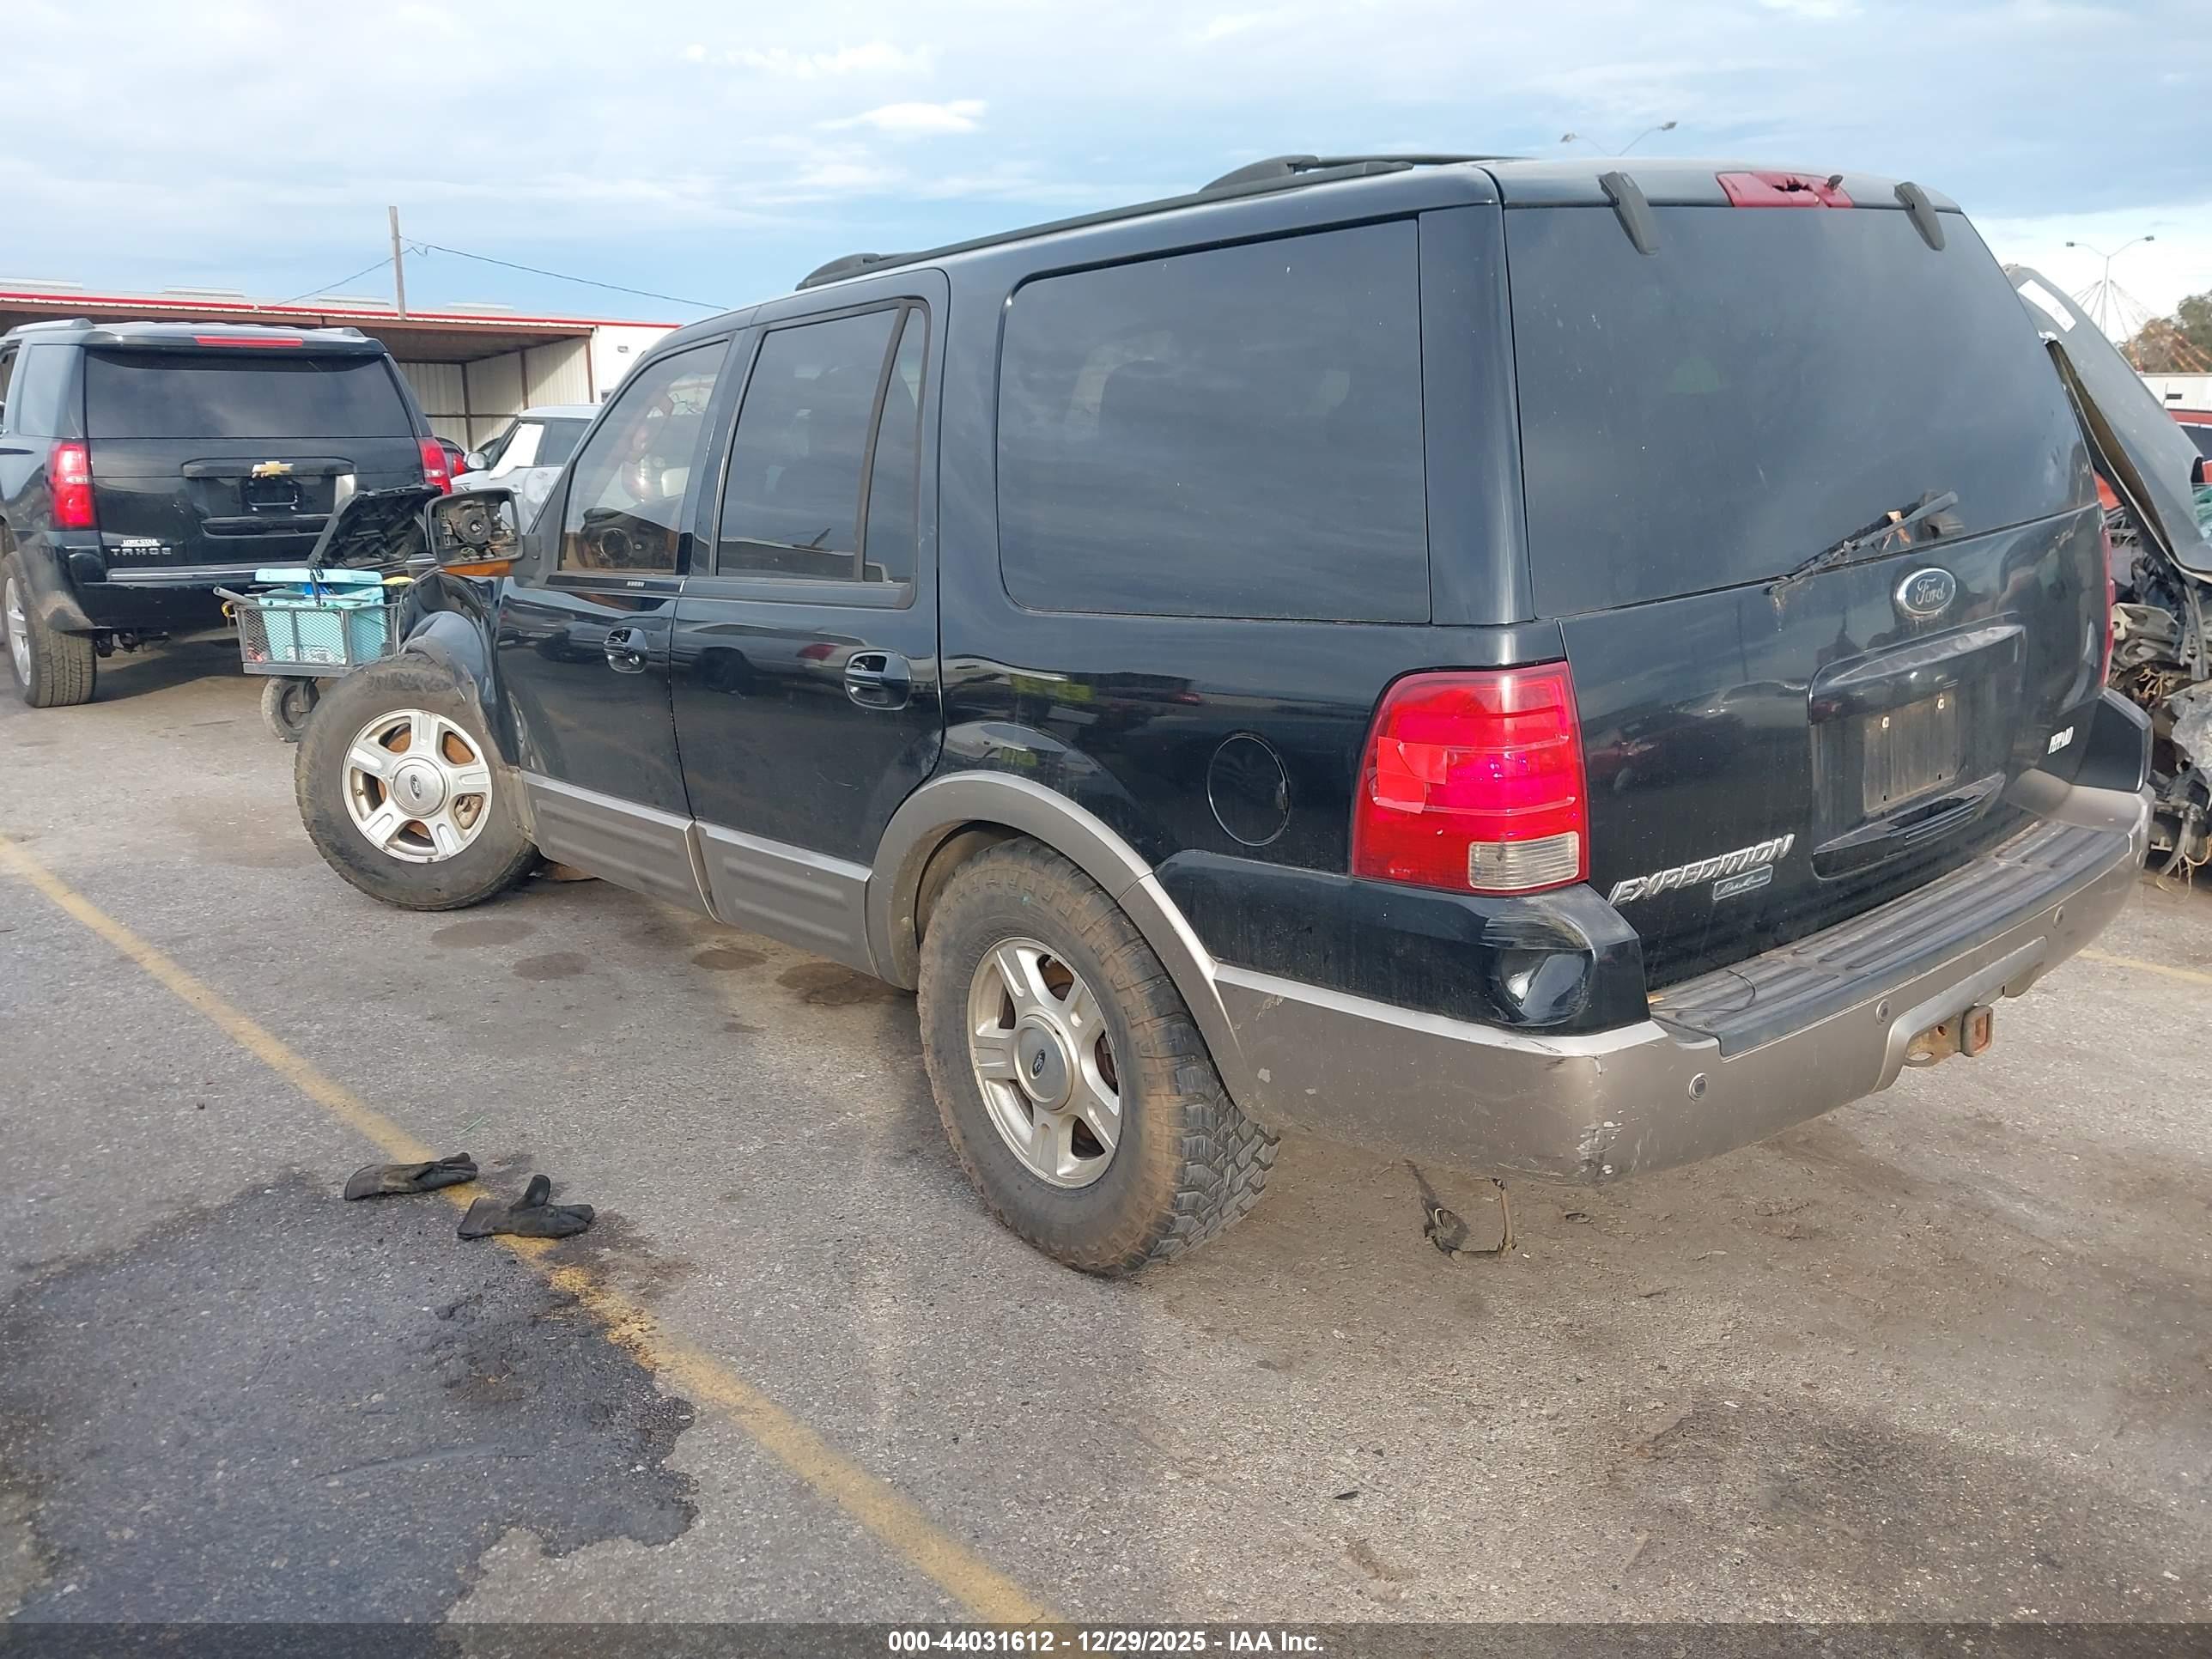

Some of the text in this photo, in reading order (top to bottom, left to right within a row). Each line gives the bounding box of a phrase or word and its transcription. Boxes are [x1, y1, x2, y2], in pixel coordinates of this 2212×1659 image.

[110, 546, 173, 556] TAHOE
[1916, 577, 1946, 605] Ford
[1607, 833, 1796, 906] EXPEDITION
